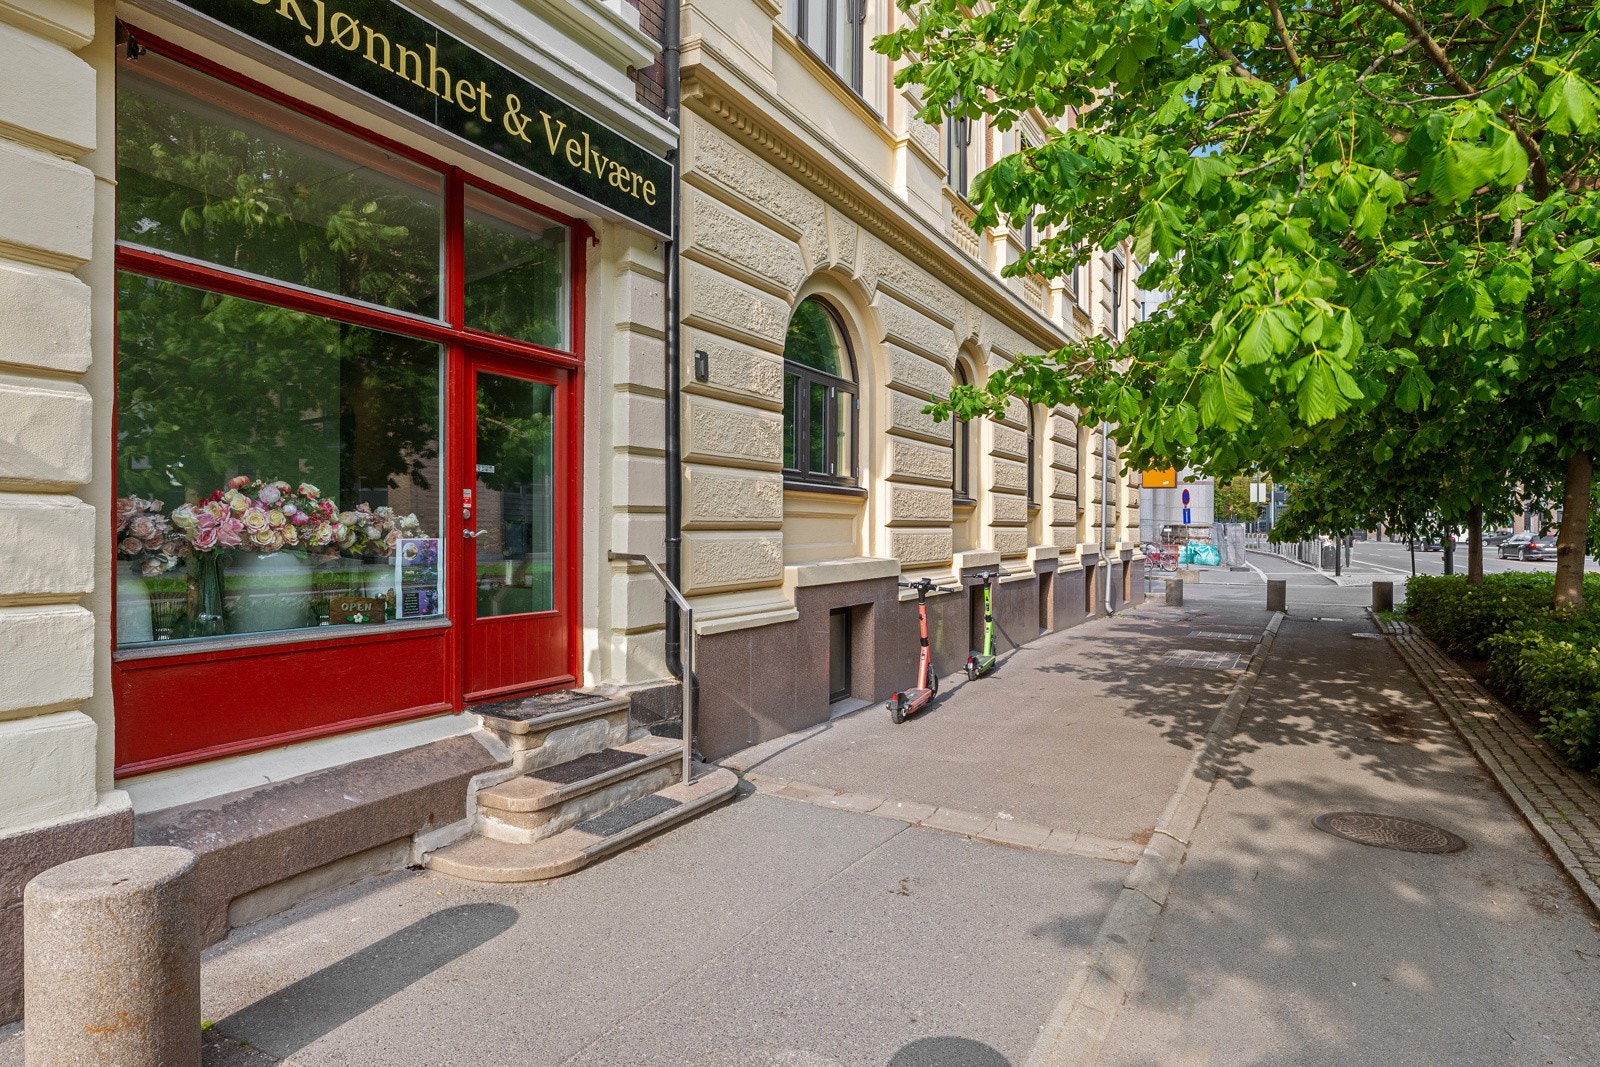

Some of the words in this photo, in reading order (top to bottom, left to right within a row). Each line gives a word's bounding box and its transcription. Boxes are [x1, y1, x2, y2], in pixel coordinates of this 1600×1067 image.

[252, 0, 492, 122] jønnhet
[502, 93, 532, 144] &
[539, 110, 657, 206] Velvære
[341, 602, 372, 612] OPEN
